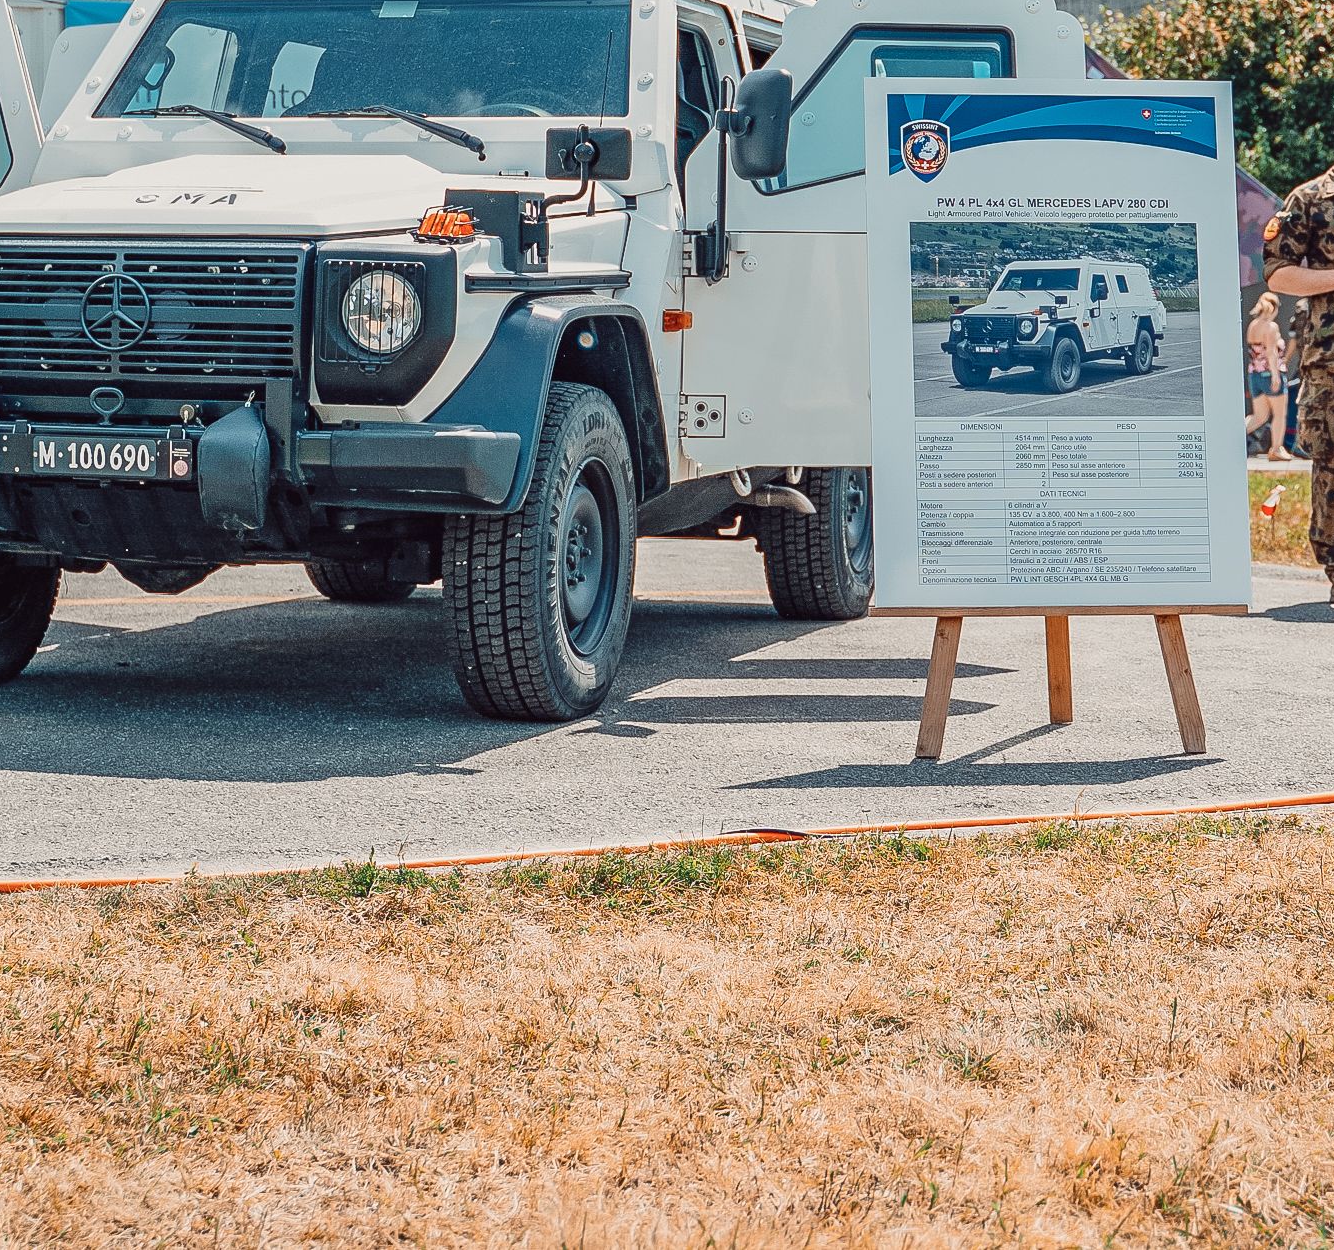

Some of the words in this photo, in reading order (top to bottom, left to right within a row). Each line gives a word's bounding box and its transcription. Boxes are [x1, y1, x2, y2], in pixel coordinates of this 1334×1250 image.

[937, 198, 957, 207] PW
[959, 198, 965, 207] 4
[968, 198, 982, 207] PL
[986, 198, 1005, 207] 4x4
[1008, 199, 1024, 208] GL
[1027, 198, 1090, 208] MERCEDES
[1094, 199, 1124, 208] LAPV
[1127, 199, 1146, 208] 280
[1149, 200, 1169, 209] CDI
[1061, 211, 1086, 219] leggero
[1088, 212, 1114, 220] protetto
[1128, 211, 1178, 220] pattugliamento
